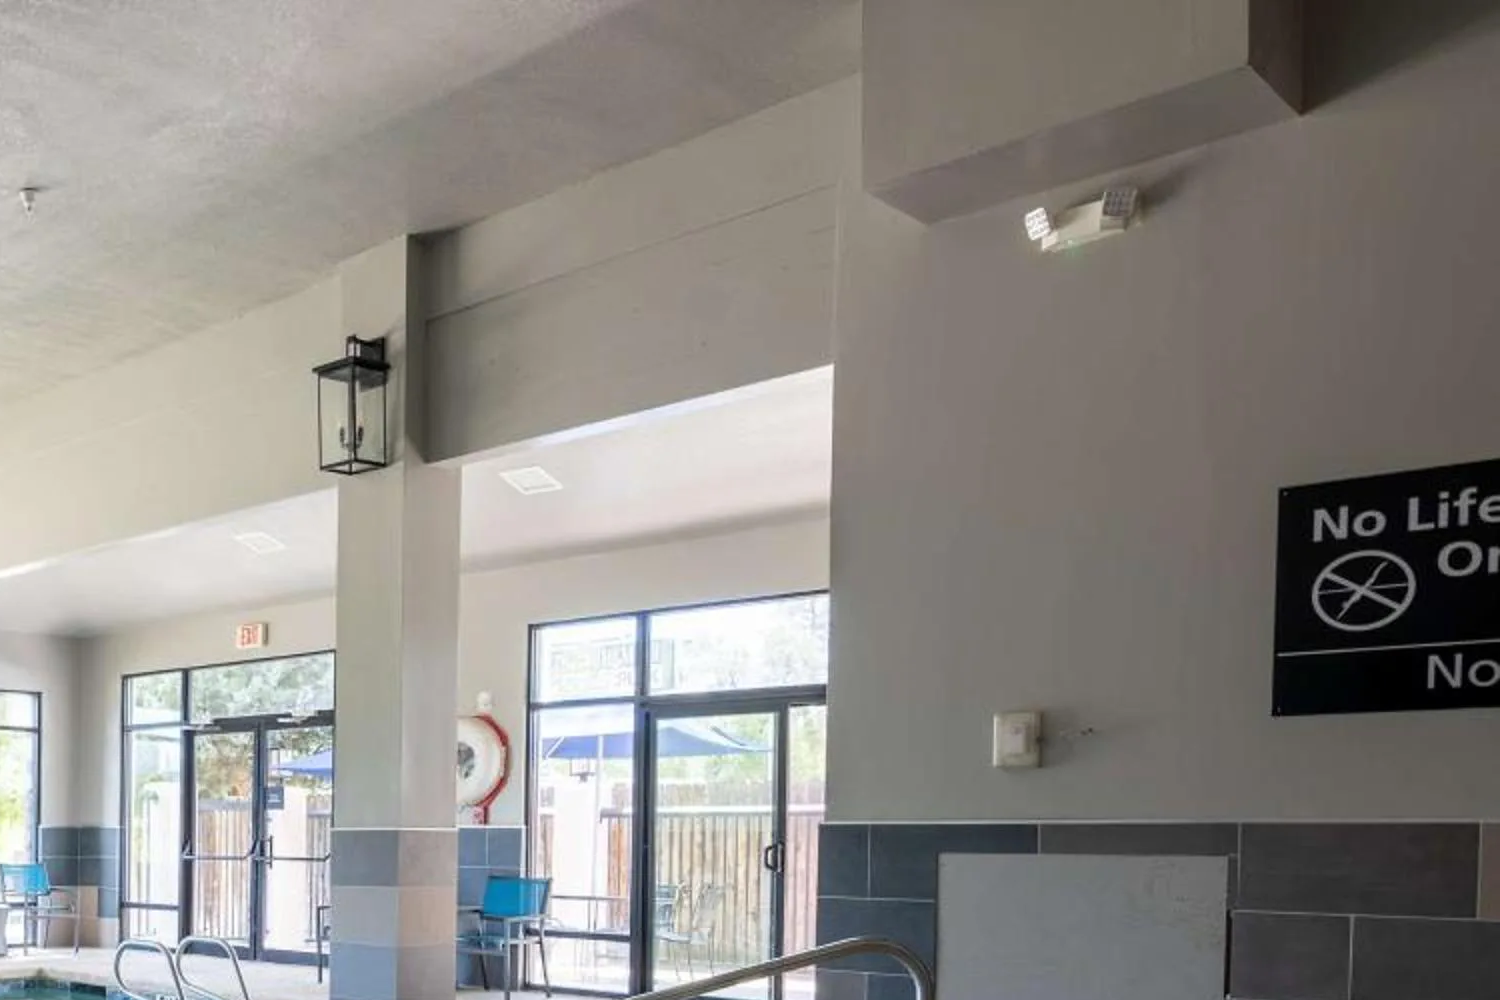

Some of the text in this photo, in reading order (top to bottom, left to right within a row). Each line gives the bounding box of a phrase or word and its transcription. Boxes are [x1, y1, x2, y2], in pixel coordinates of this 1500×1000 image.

[1312, 486, 1500, 542] No Life
[1427, 653, 1500, 689] No
